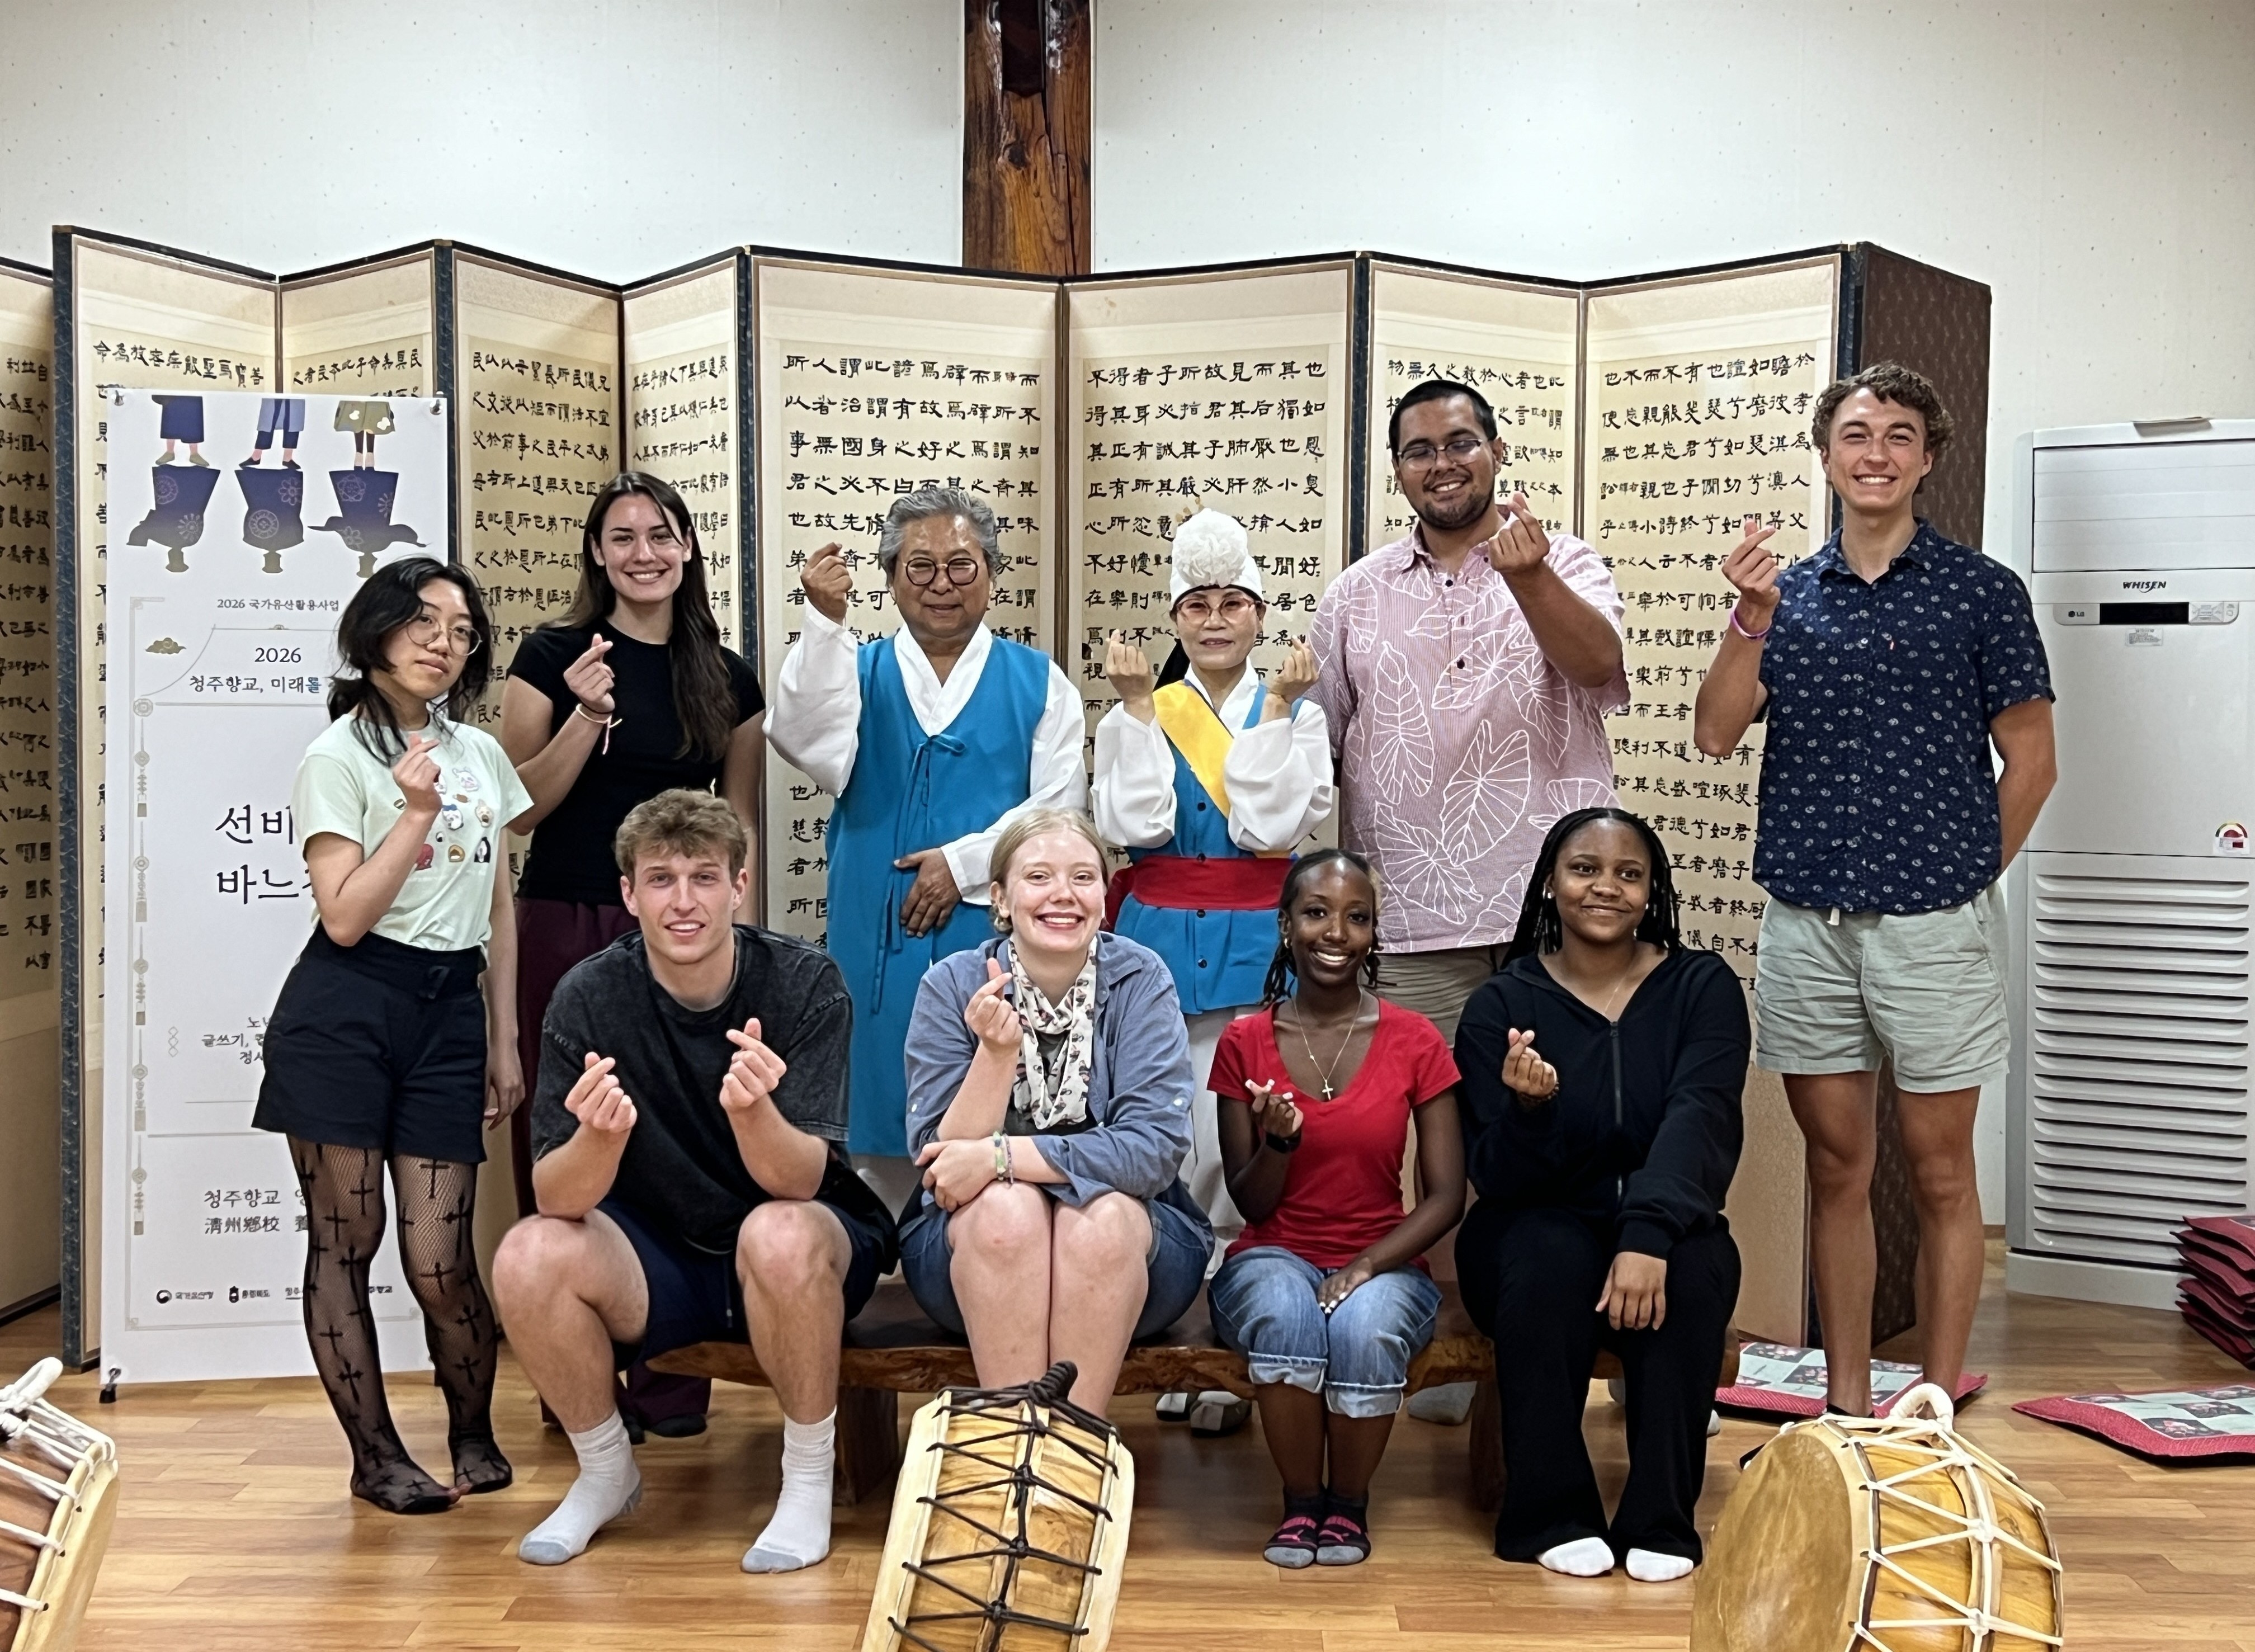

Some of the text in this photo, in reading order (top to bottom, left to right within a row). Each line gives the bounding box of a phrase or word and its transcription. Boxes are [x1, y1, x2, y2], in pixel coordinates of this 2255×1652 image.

[2123, 580, 2167, 592] WHISEN
[217, 599, 246, 608] 2026
[254, 648, 301, 663] 2026
[189, 676, 322, 693] 청주향교, 미래를
[217, 864, 312, 904] 바느
[204, 1189, 281, 1209] 청주향교
